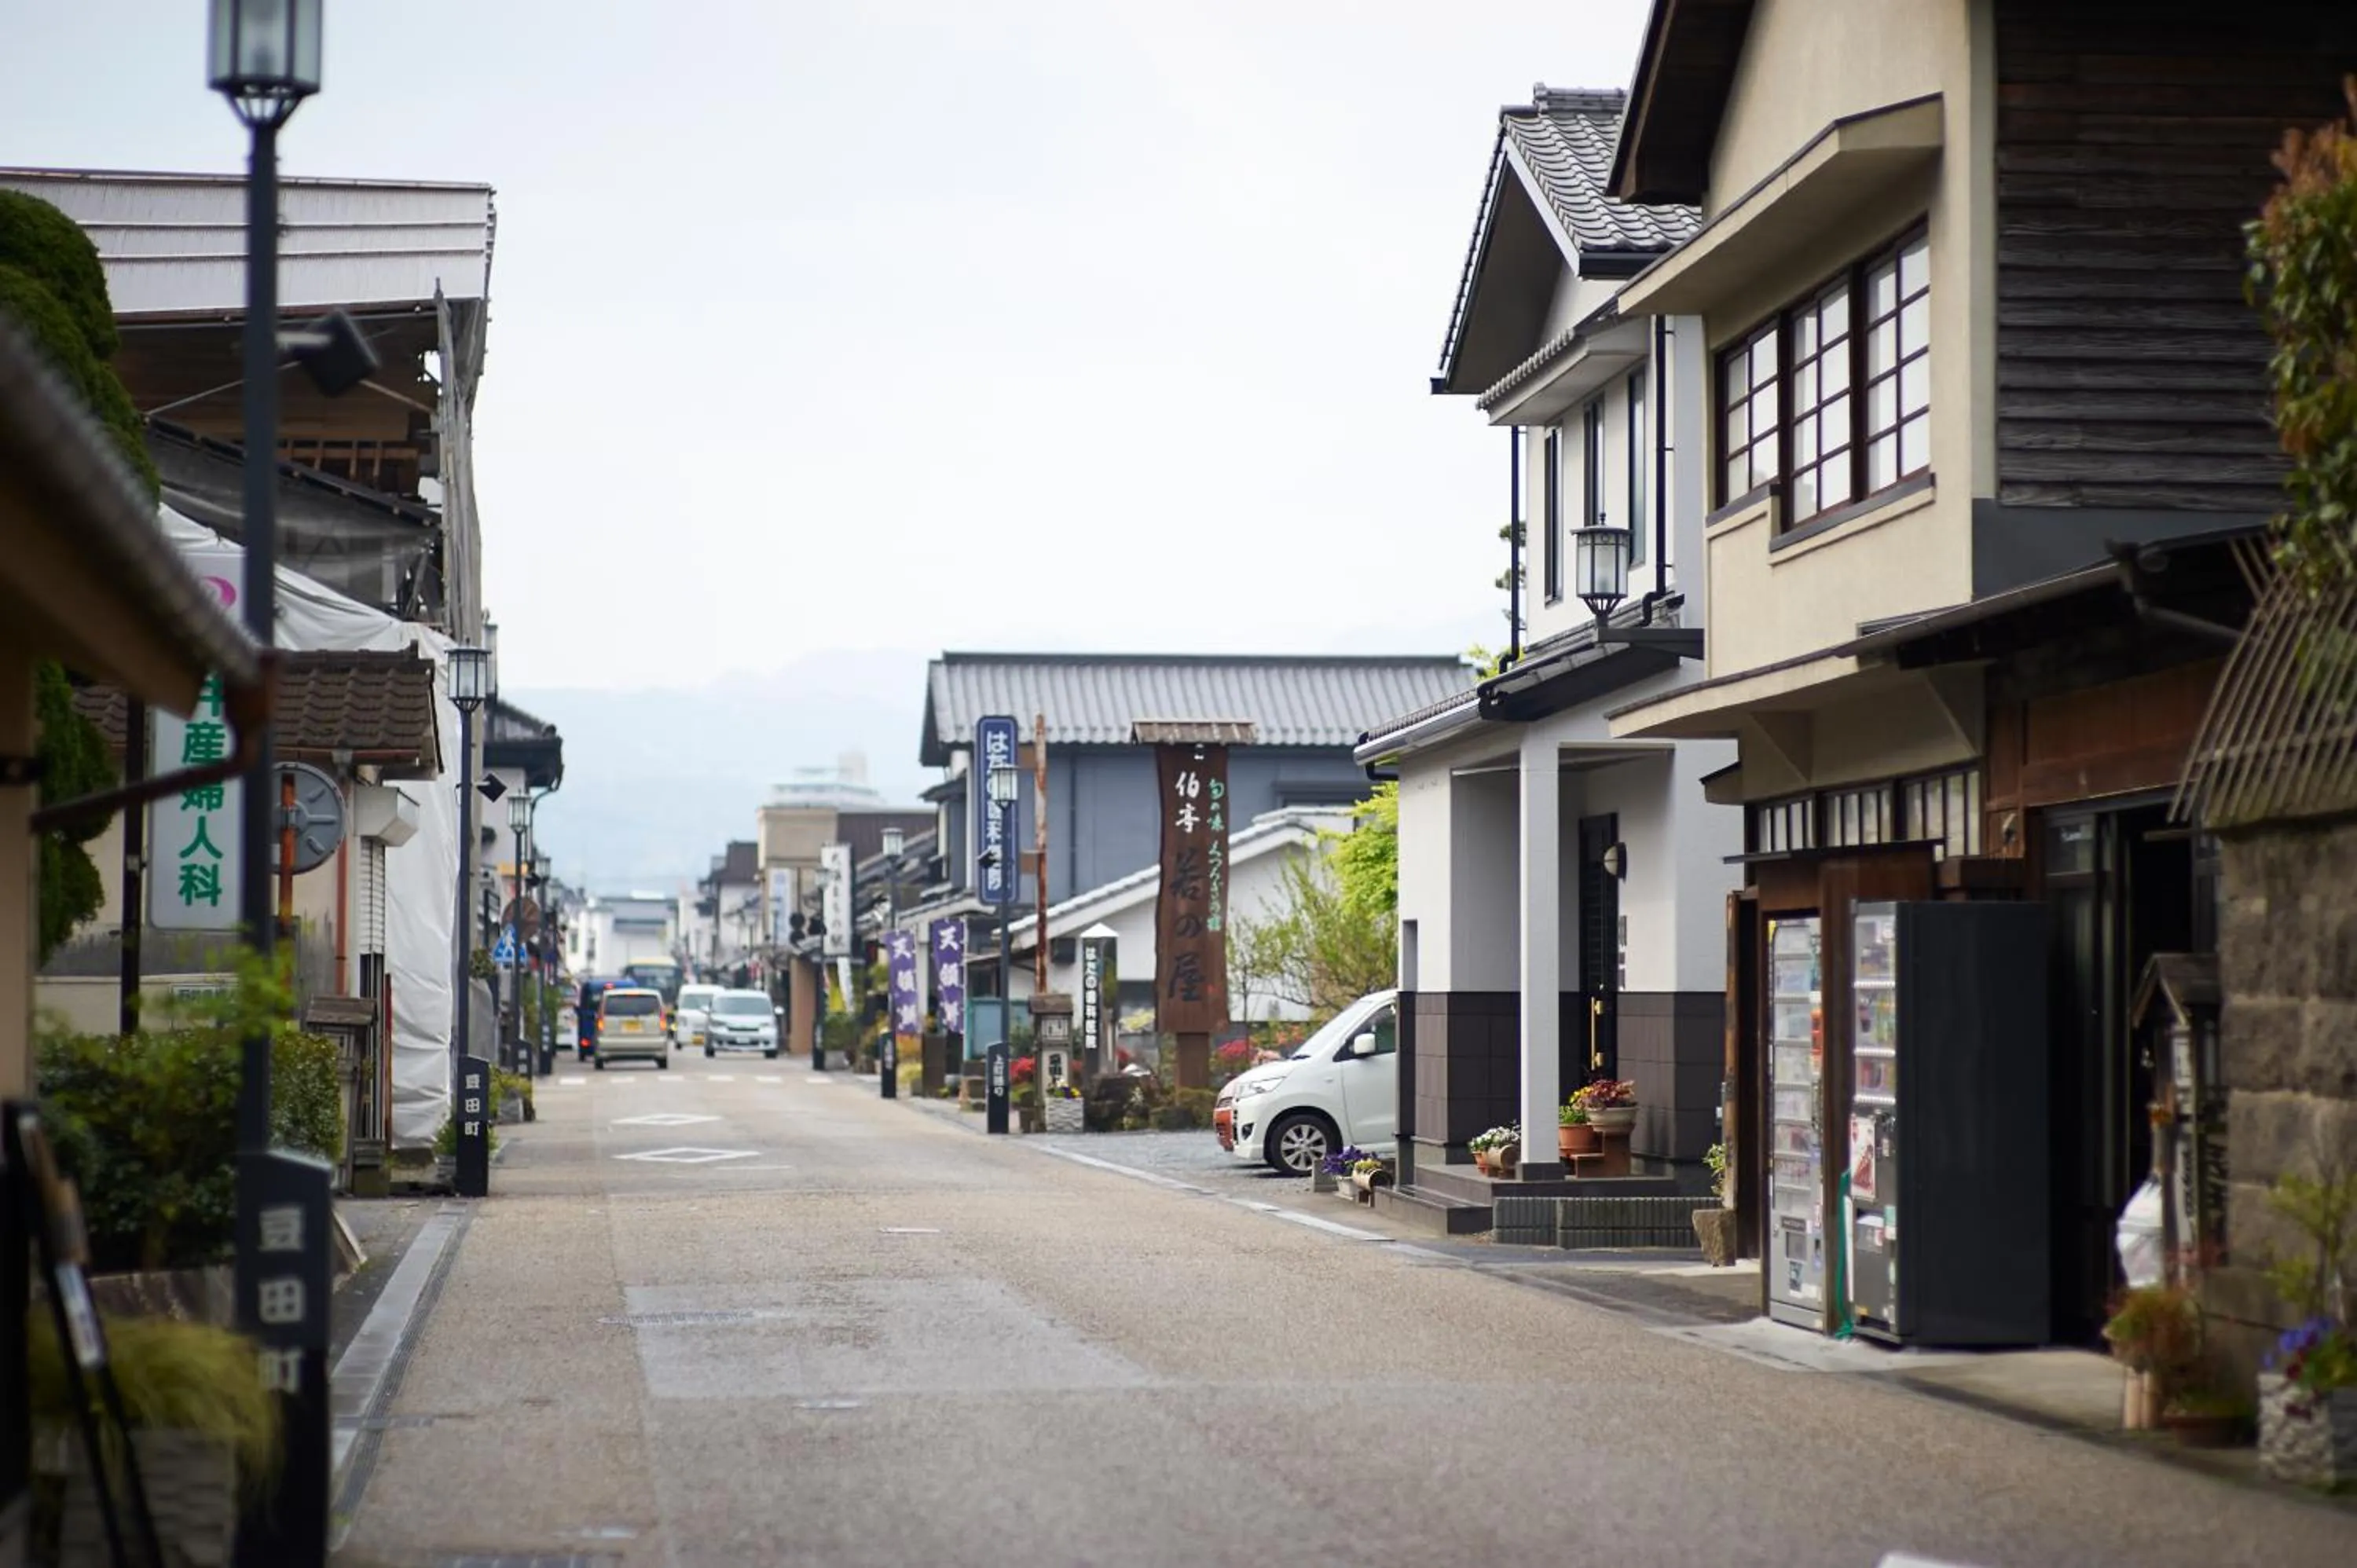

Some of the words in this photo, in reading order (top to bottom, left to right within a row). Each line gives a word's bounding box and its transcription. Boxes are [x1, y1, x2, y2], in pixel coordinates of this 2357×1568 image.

[465, 1074, 480, 1136] 豆田町
[258, 1207, 305, 1394] 豆田町
